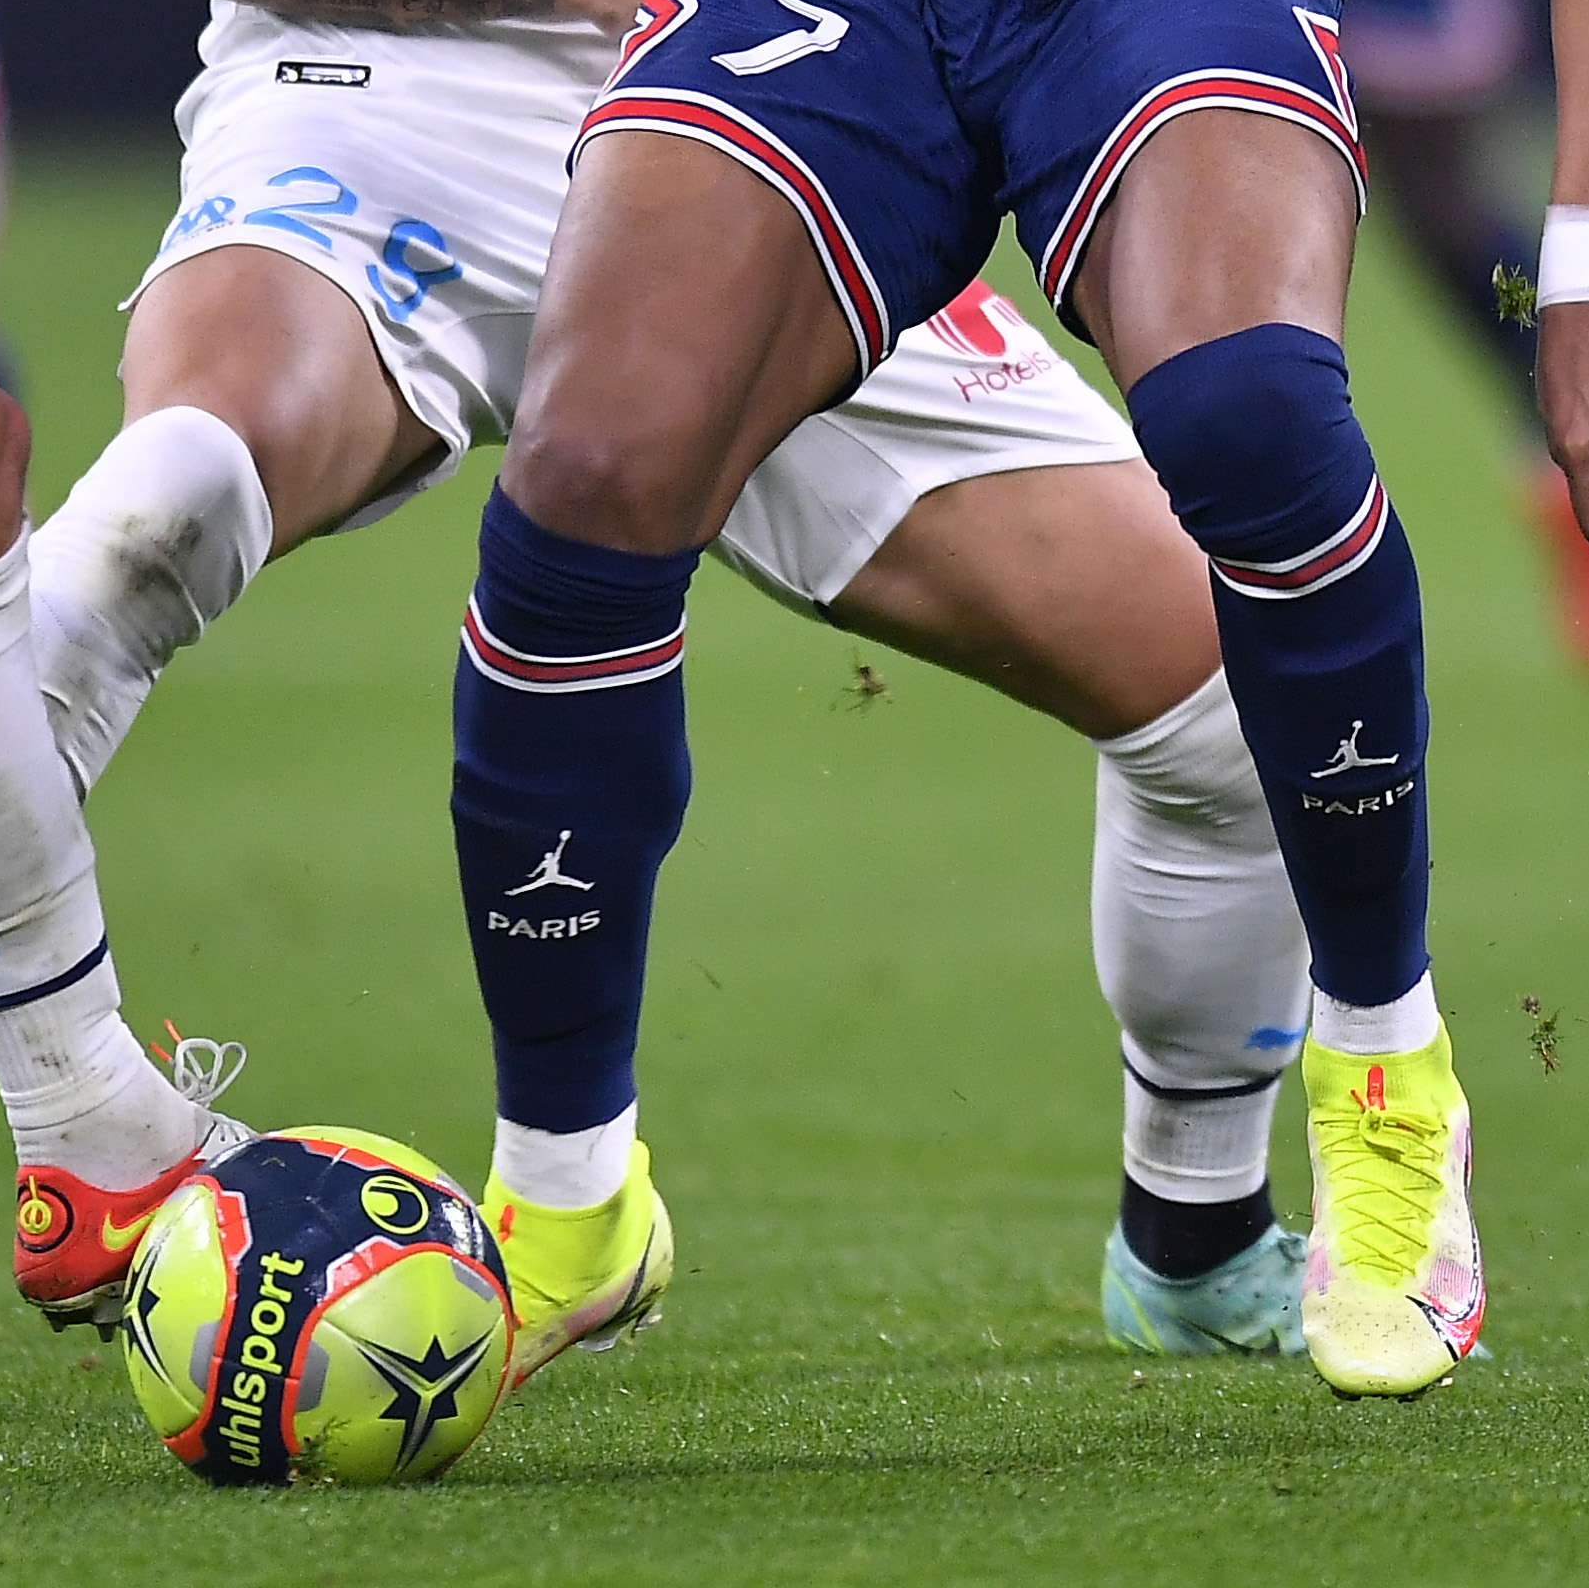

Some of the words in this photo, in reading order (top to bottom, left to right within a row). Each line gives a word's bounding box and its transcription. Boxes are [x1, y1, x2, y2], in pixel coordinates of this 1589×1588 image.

[953, 351, 1052, 403] Hotels
[1302, 779, 1414, 815] PARIS
[488, 910, 600, 939] PARIS
[219, 1251, 305, 1468] uhlsport
